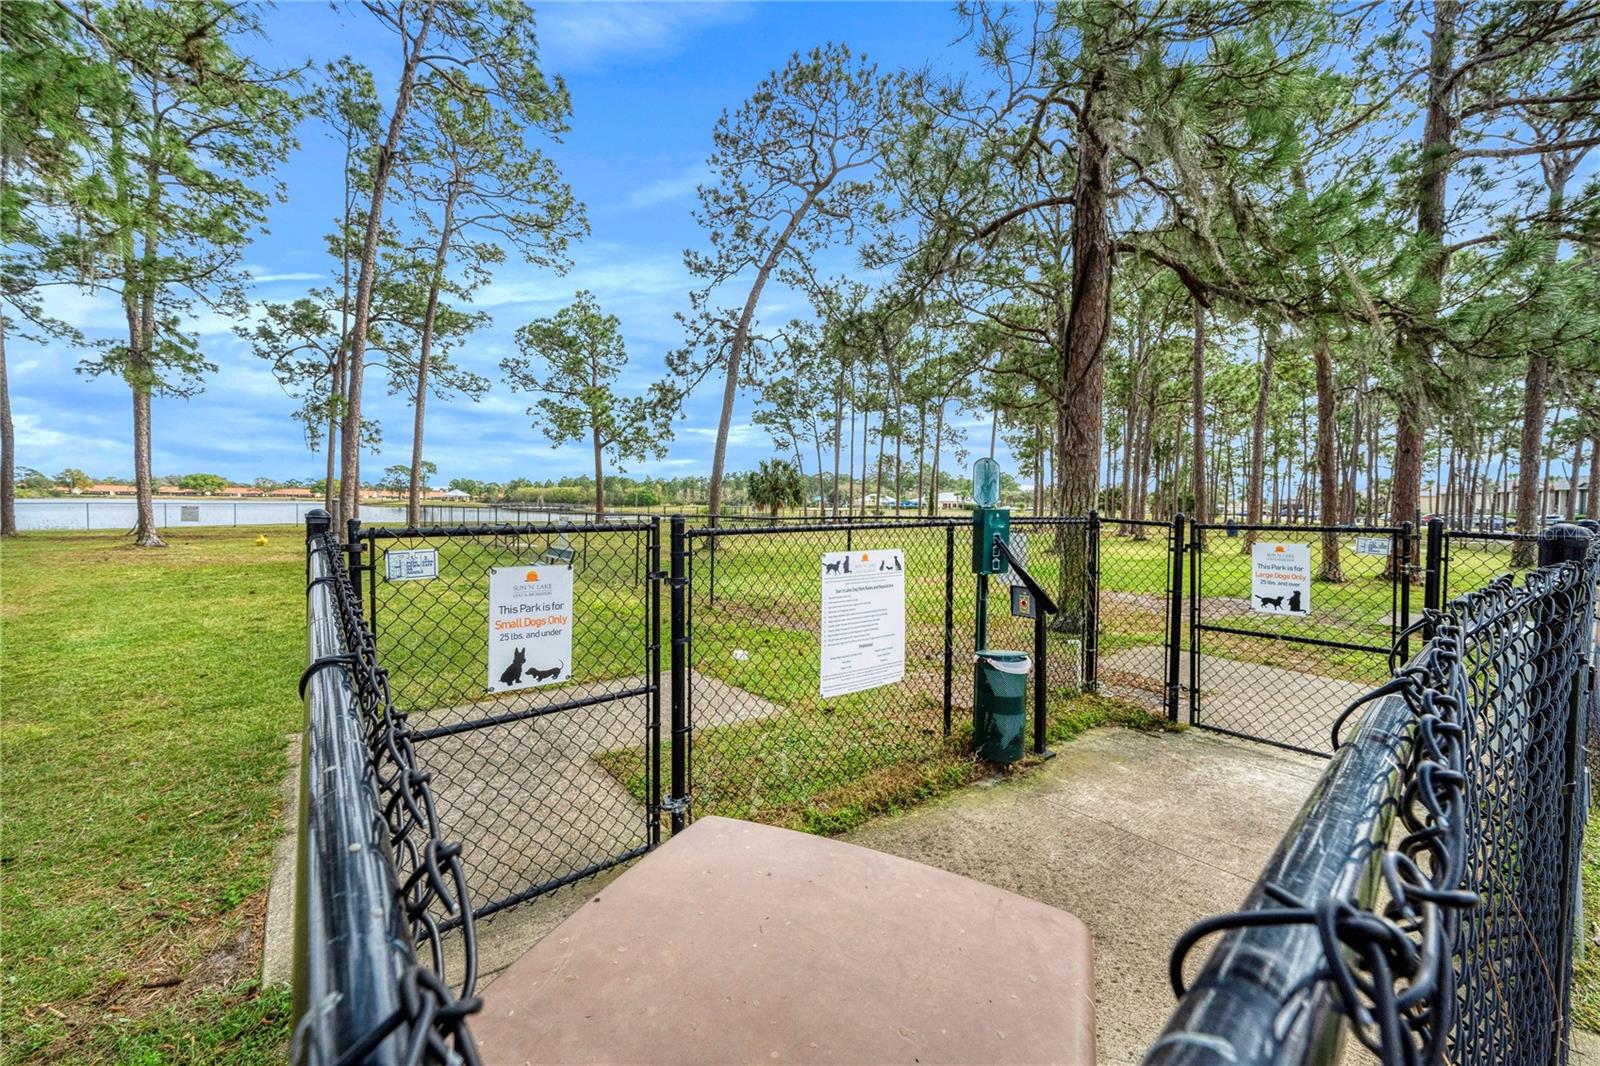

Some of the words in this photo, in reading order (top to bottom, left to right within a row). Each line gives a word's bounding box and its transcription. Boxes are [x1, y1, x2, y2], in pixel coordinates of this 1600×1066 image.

[498, 605, 518, 614] This
[520, 603, 541, 612] Park
[542, 602, 550, 611] is
[552, 602, 564, 610] for
[495, 619, 522, 630] Small
[524, 617, 546, 628] Dogs
[548, 614, 568, 625] Only
[500, 632, 510, 641] 25
[510, 632, 524, 640] lbs.
[526, 630, 540, 638] and
[540, 628, 563, 638] under
